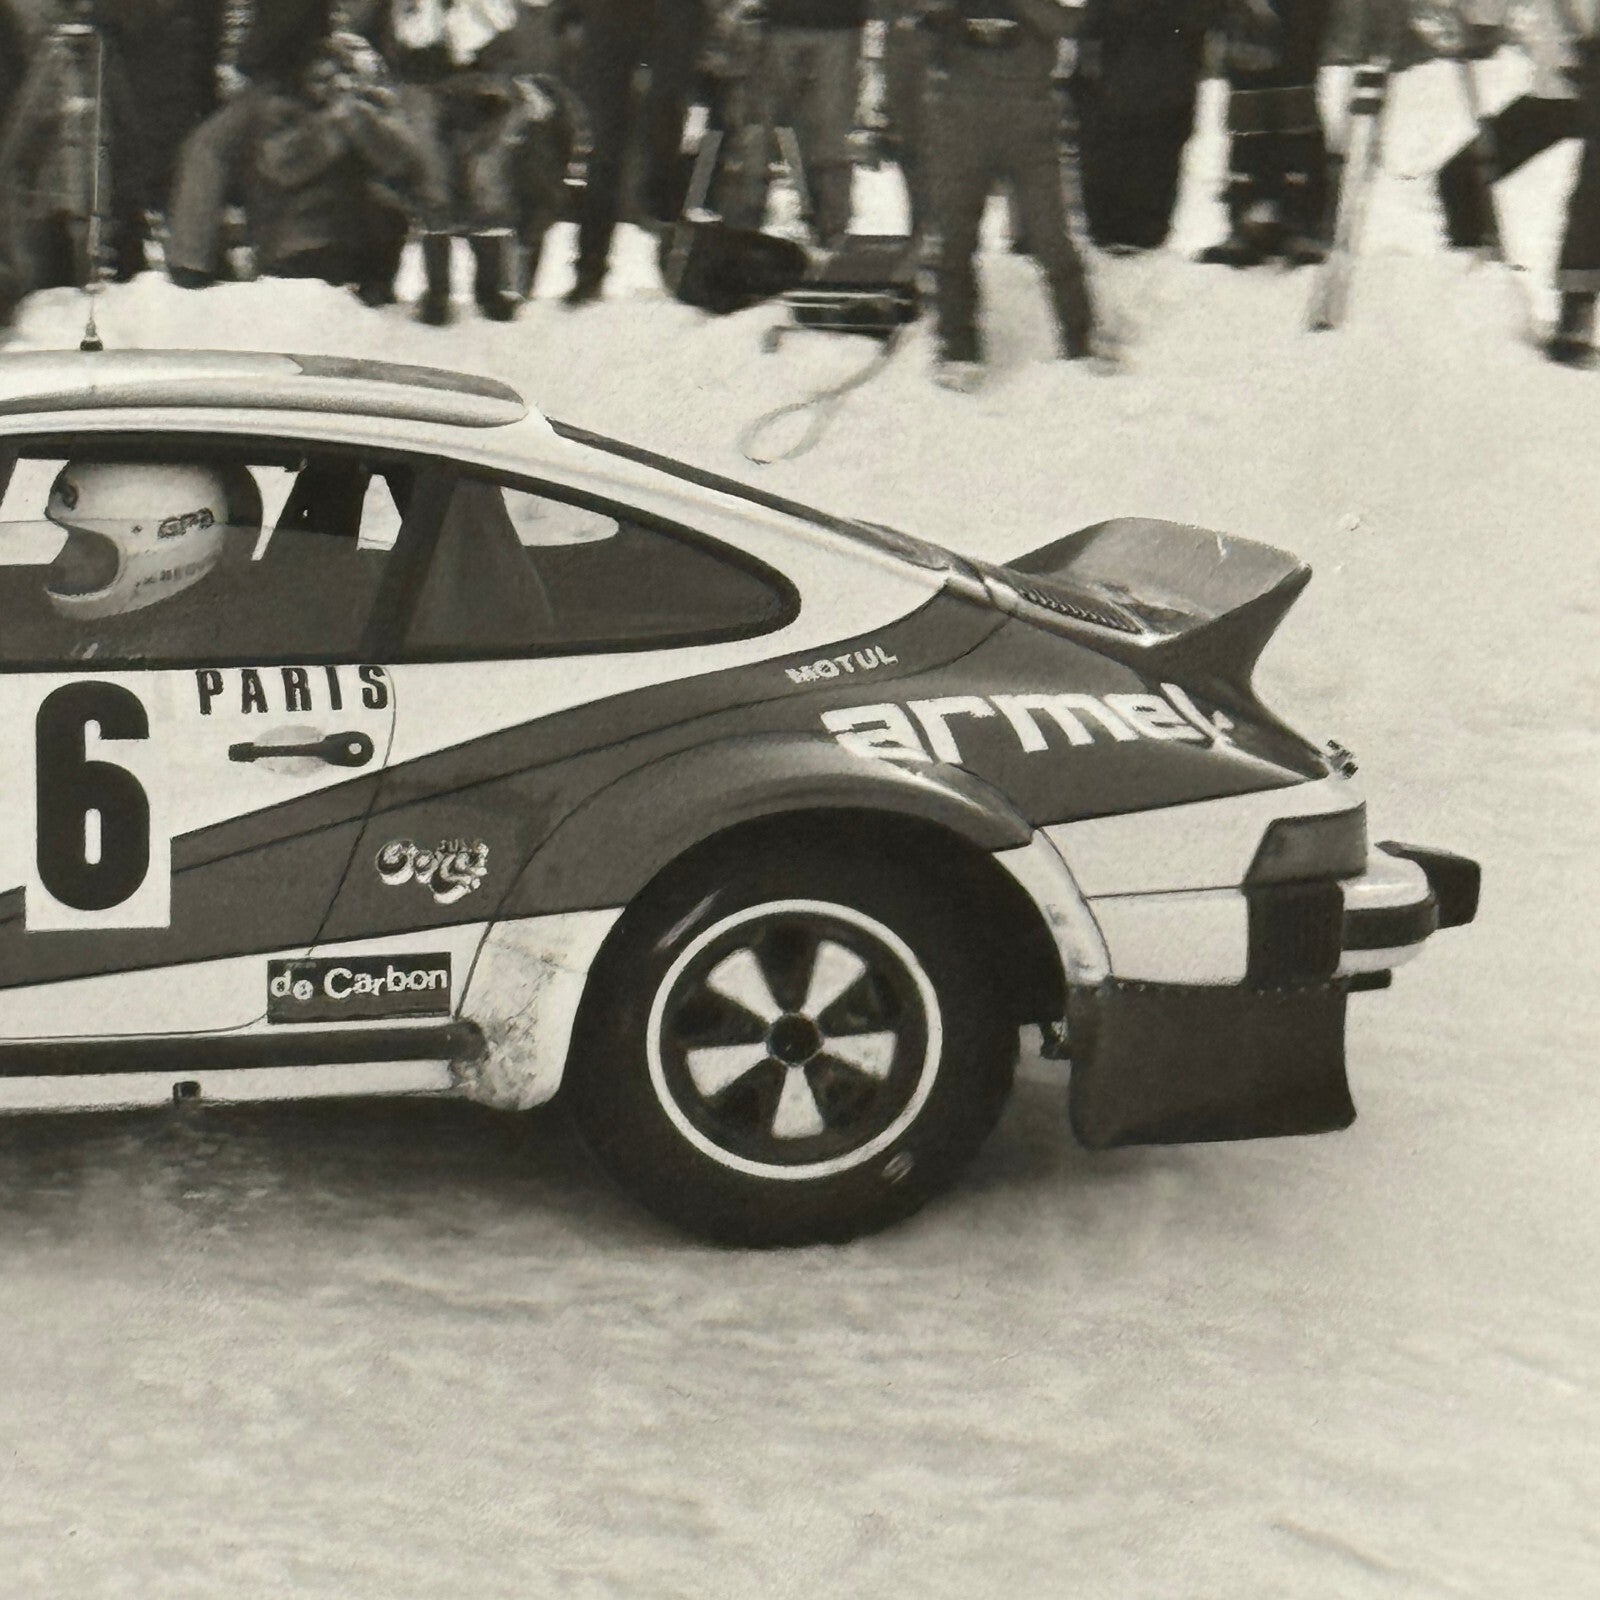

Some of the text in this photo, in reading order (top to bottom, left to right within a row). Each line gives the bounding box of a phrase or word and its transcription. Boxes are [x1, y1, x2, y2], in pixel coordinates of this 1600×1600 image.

[784, 645, 899, 684] MOTUL
[195, 665, 389, 715] PARIS
[35, 679, 151, 911] 6
[323, 964, 449, 1000] Carbon
